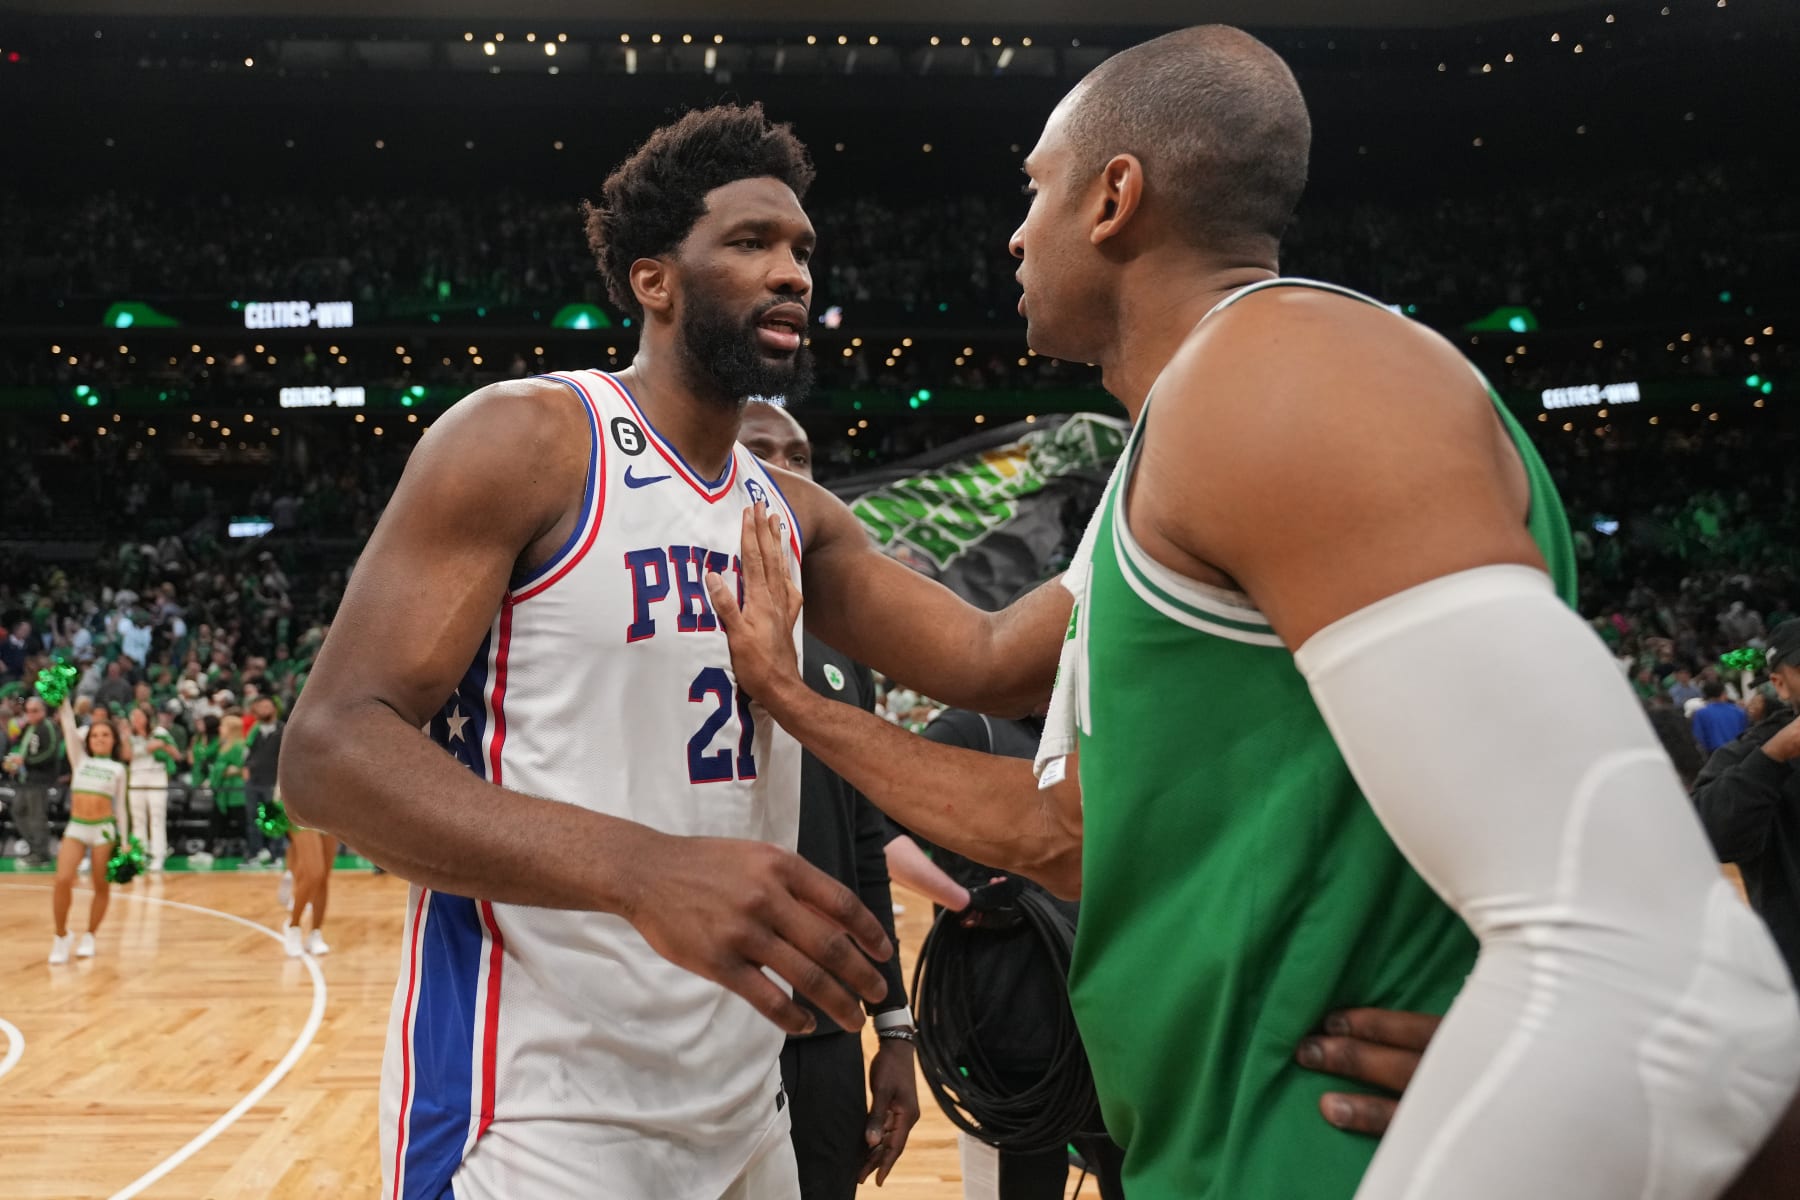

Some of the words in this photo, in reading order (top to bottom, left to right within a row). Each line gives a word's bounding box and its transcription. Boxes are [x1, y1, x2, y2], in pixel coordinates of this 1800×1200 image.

[617, 422, 639, 451] 6
[624, 545, 745, 643] PH
[687, 667, 757, 784] 21
